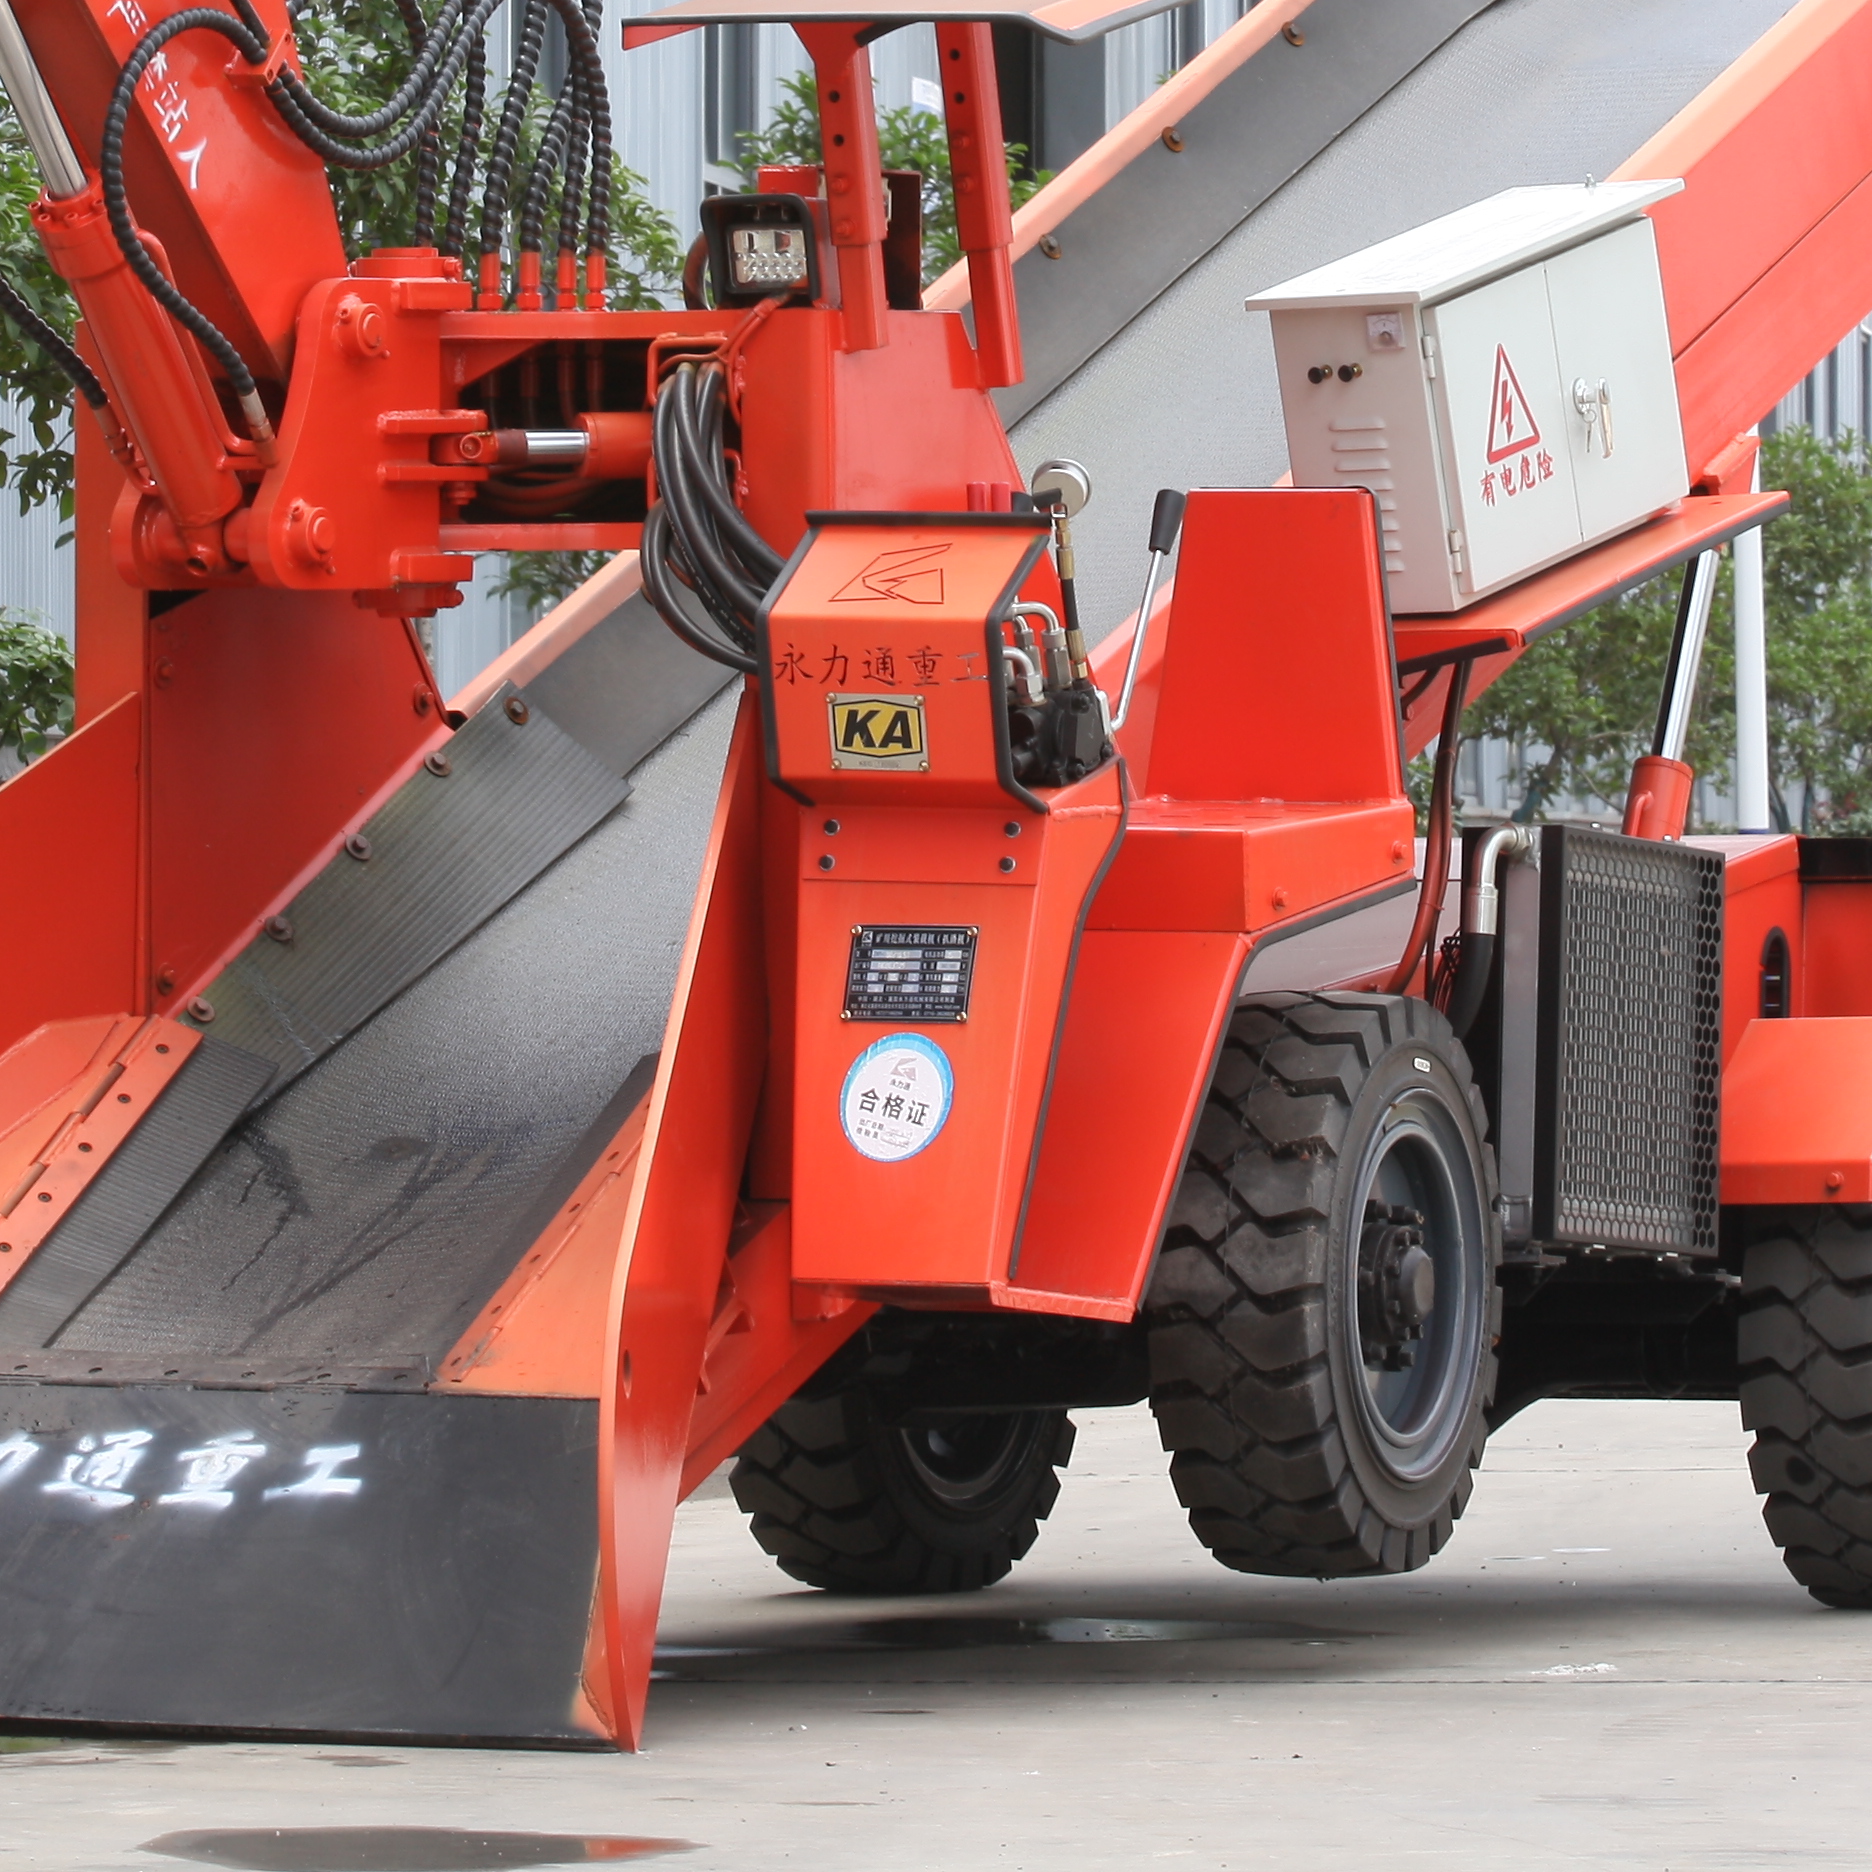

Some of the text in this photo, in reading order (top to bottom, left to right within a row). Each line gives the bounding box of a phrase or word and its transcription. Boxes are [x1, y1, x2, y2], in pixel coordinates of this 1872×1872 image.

[1479, 446, 1555, 508] 有电危险
[774, 642, 989, 687] 永力通重工
[842, 708, 914, 749] KA
[858, 1087, 931, 1127] 合格证
